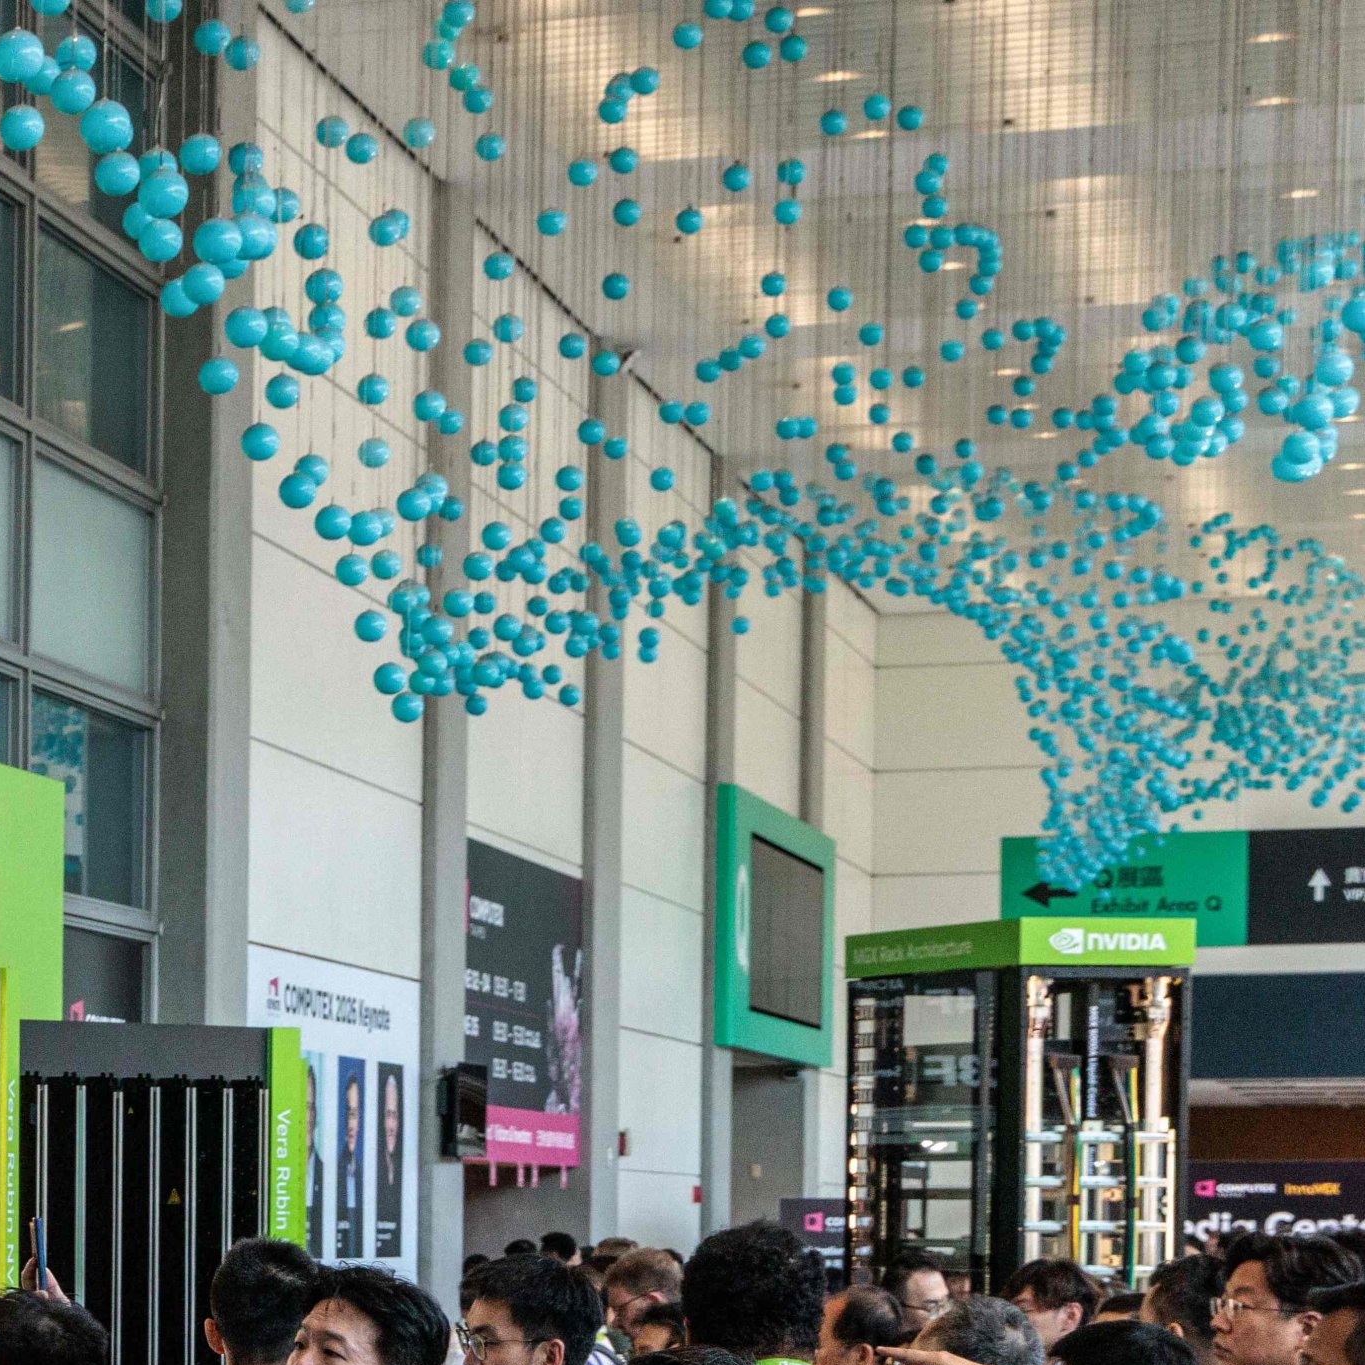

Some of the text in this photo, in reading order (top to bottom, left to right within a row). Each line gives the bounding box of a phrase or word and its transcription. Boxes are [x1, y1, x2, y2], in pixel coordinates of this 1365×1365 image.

[1090, 898, 1149, 914] Exhibit
[1155, 900, 1198, 913] Area
[284, 983, 333, 1020] COMPUTEX
[358, 998, 390, 1033] Keynote
[6, 1079, 16, 1233] Vera Rubin
[275, 1109, 291, 1230] Vera Rubin
